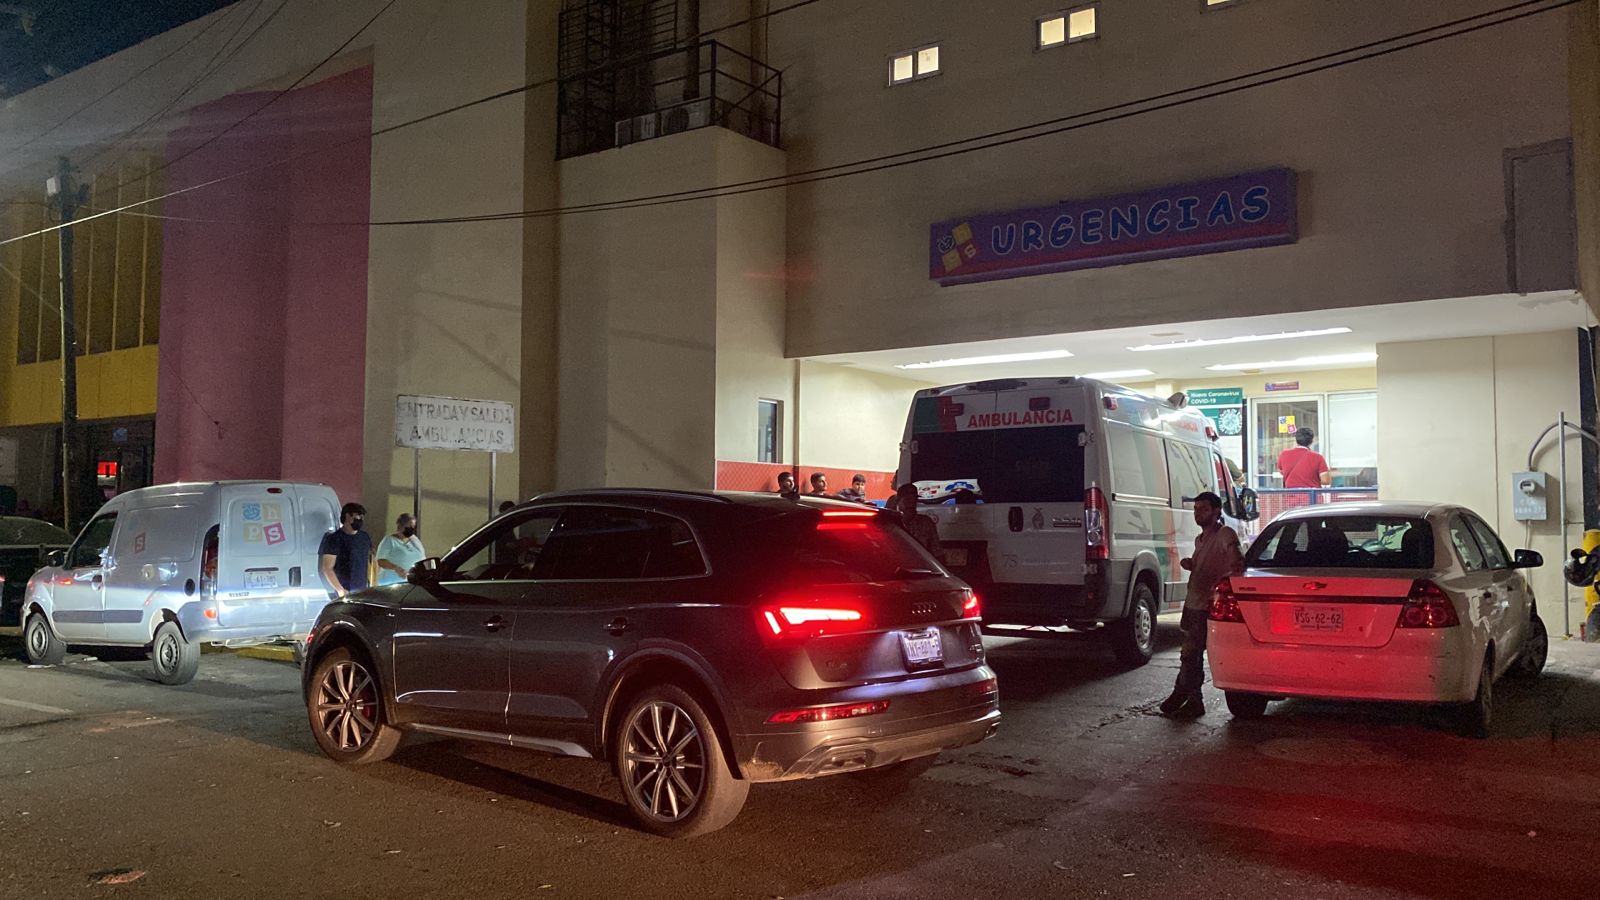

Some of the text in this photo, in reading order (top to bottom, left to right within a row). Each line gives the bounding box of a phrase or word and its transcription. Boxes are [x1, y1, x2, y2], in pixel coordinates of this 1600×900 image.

[991, 185, 1271, 255] URGENCIAS
[1190, 397, 1217, 405] COVID-19
[968, 408, 1073, 428] AMBULANCIA
[1294, 610, 1341, 625] VSG-62-62
